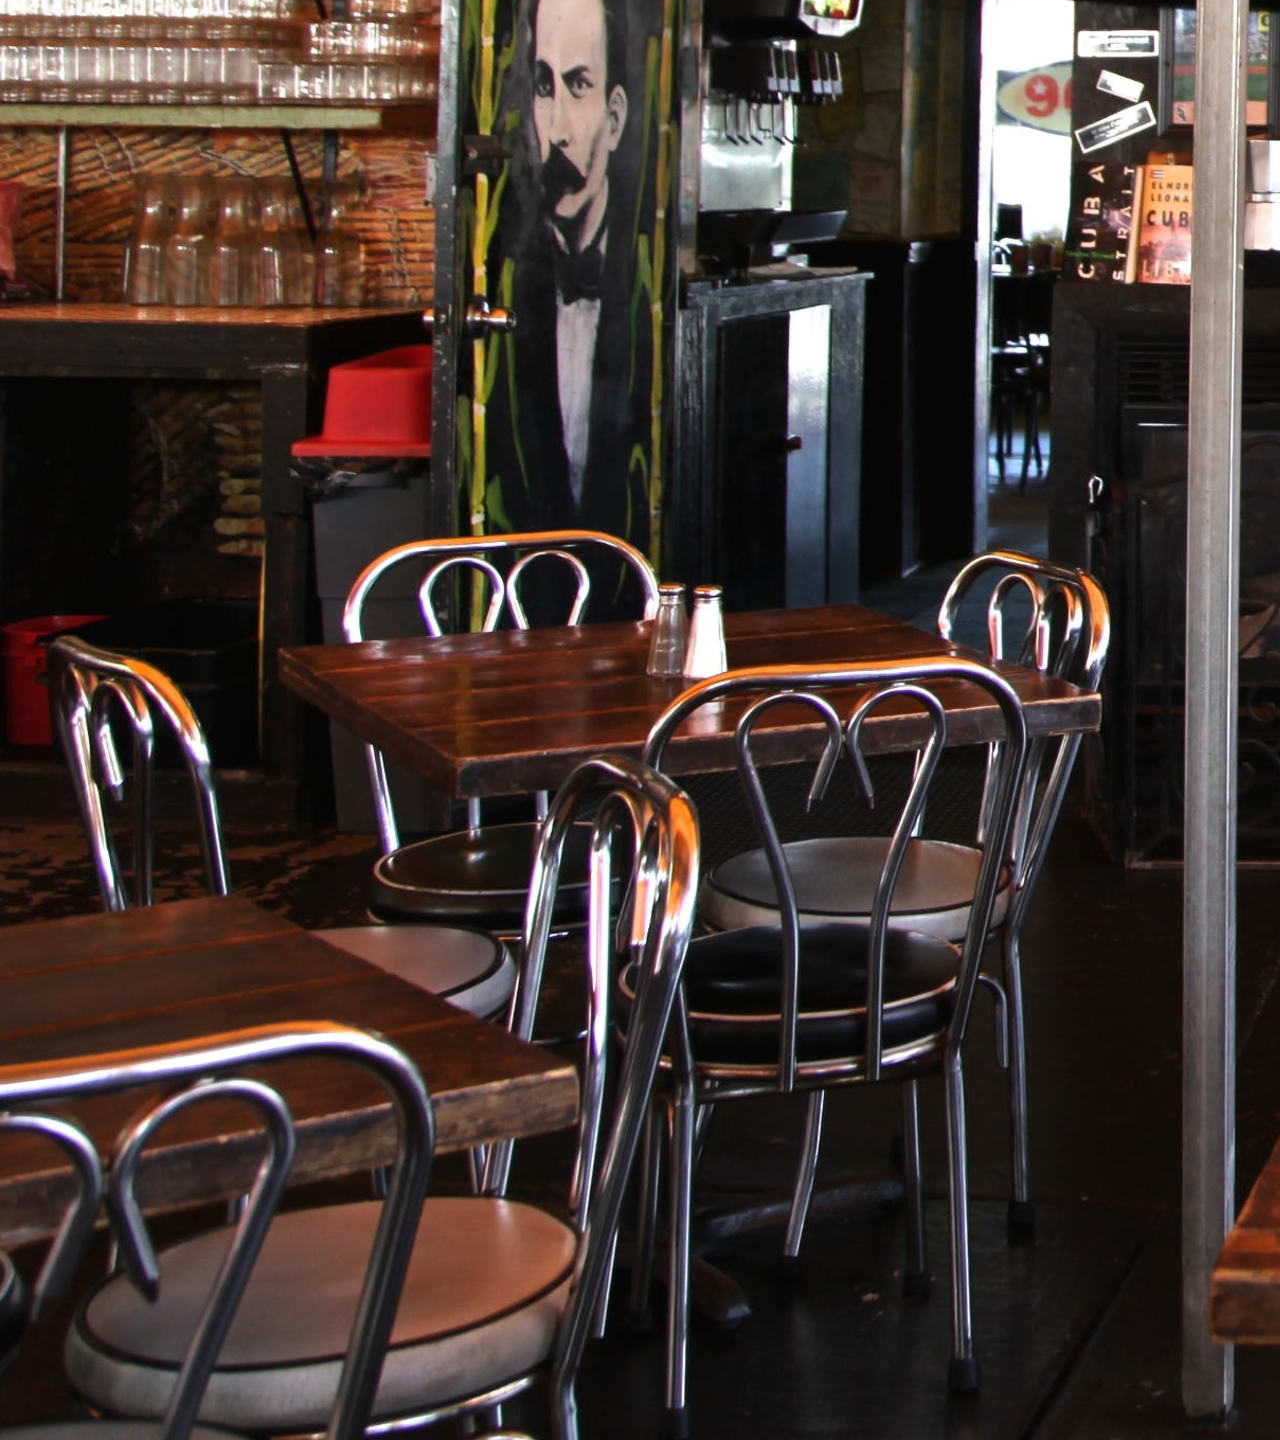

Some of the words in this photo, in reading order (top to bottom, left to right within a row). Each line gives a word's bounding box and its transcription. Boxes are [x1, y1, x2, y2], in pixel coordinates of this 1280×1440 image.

[1151, 181, 1190, 190] ELMOR
[1150, 193, 1190, 203] LEONA
[1078, 164, 1105, 279] CUBA
[1112, 166, 1135, 281] STRAIT
[1147, 210, 1190, 228] CUB
